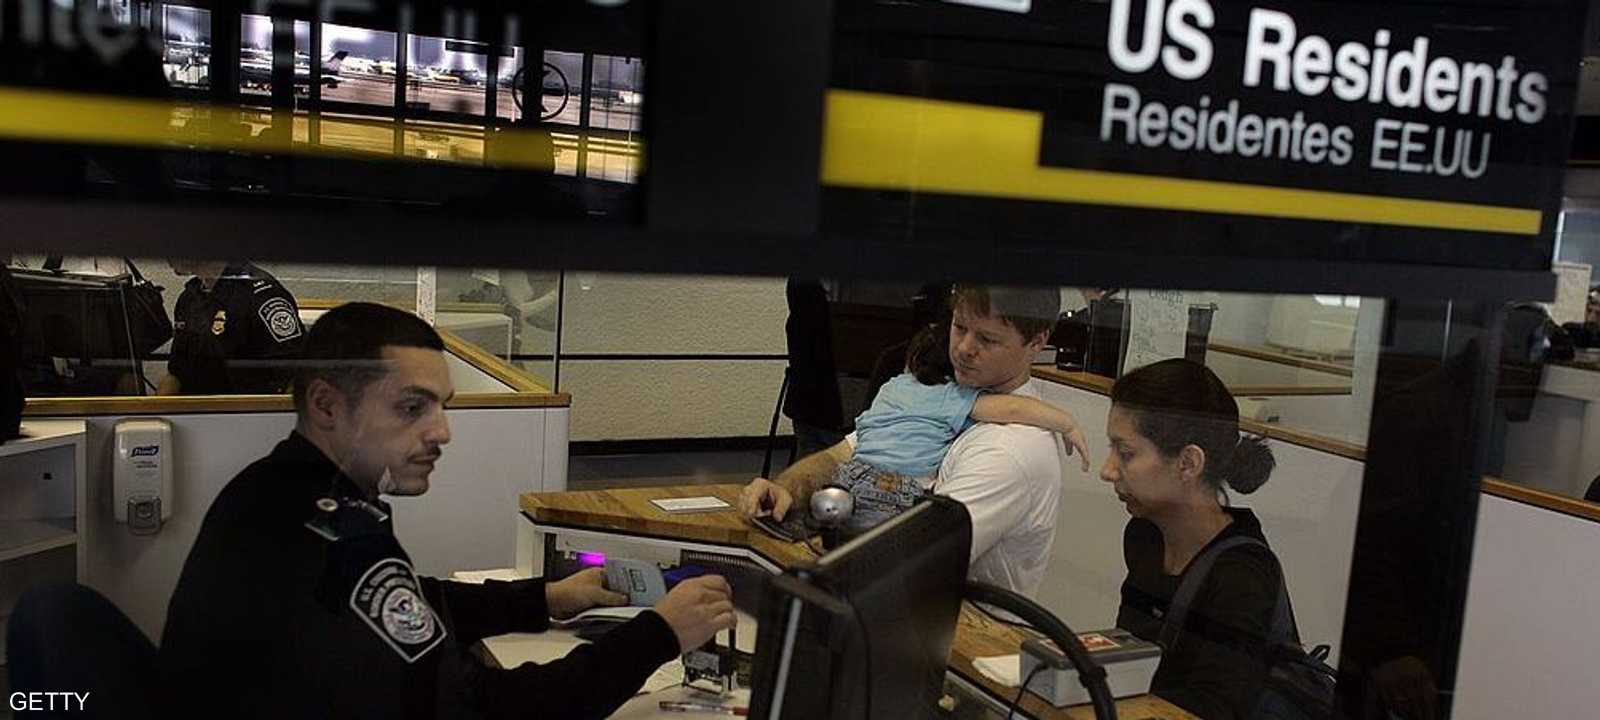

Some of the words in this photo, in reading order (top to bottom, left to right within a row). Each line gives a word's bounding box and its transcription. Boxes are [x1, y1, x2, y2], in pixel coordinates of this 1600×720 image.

[1107, 0, 1216, 81] US
[1242, 6, 1549, 124] Residents
[1101, 81, 1355, 166] Residentes
[1370, 117, 1492, 178] EE.UU
